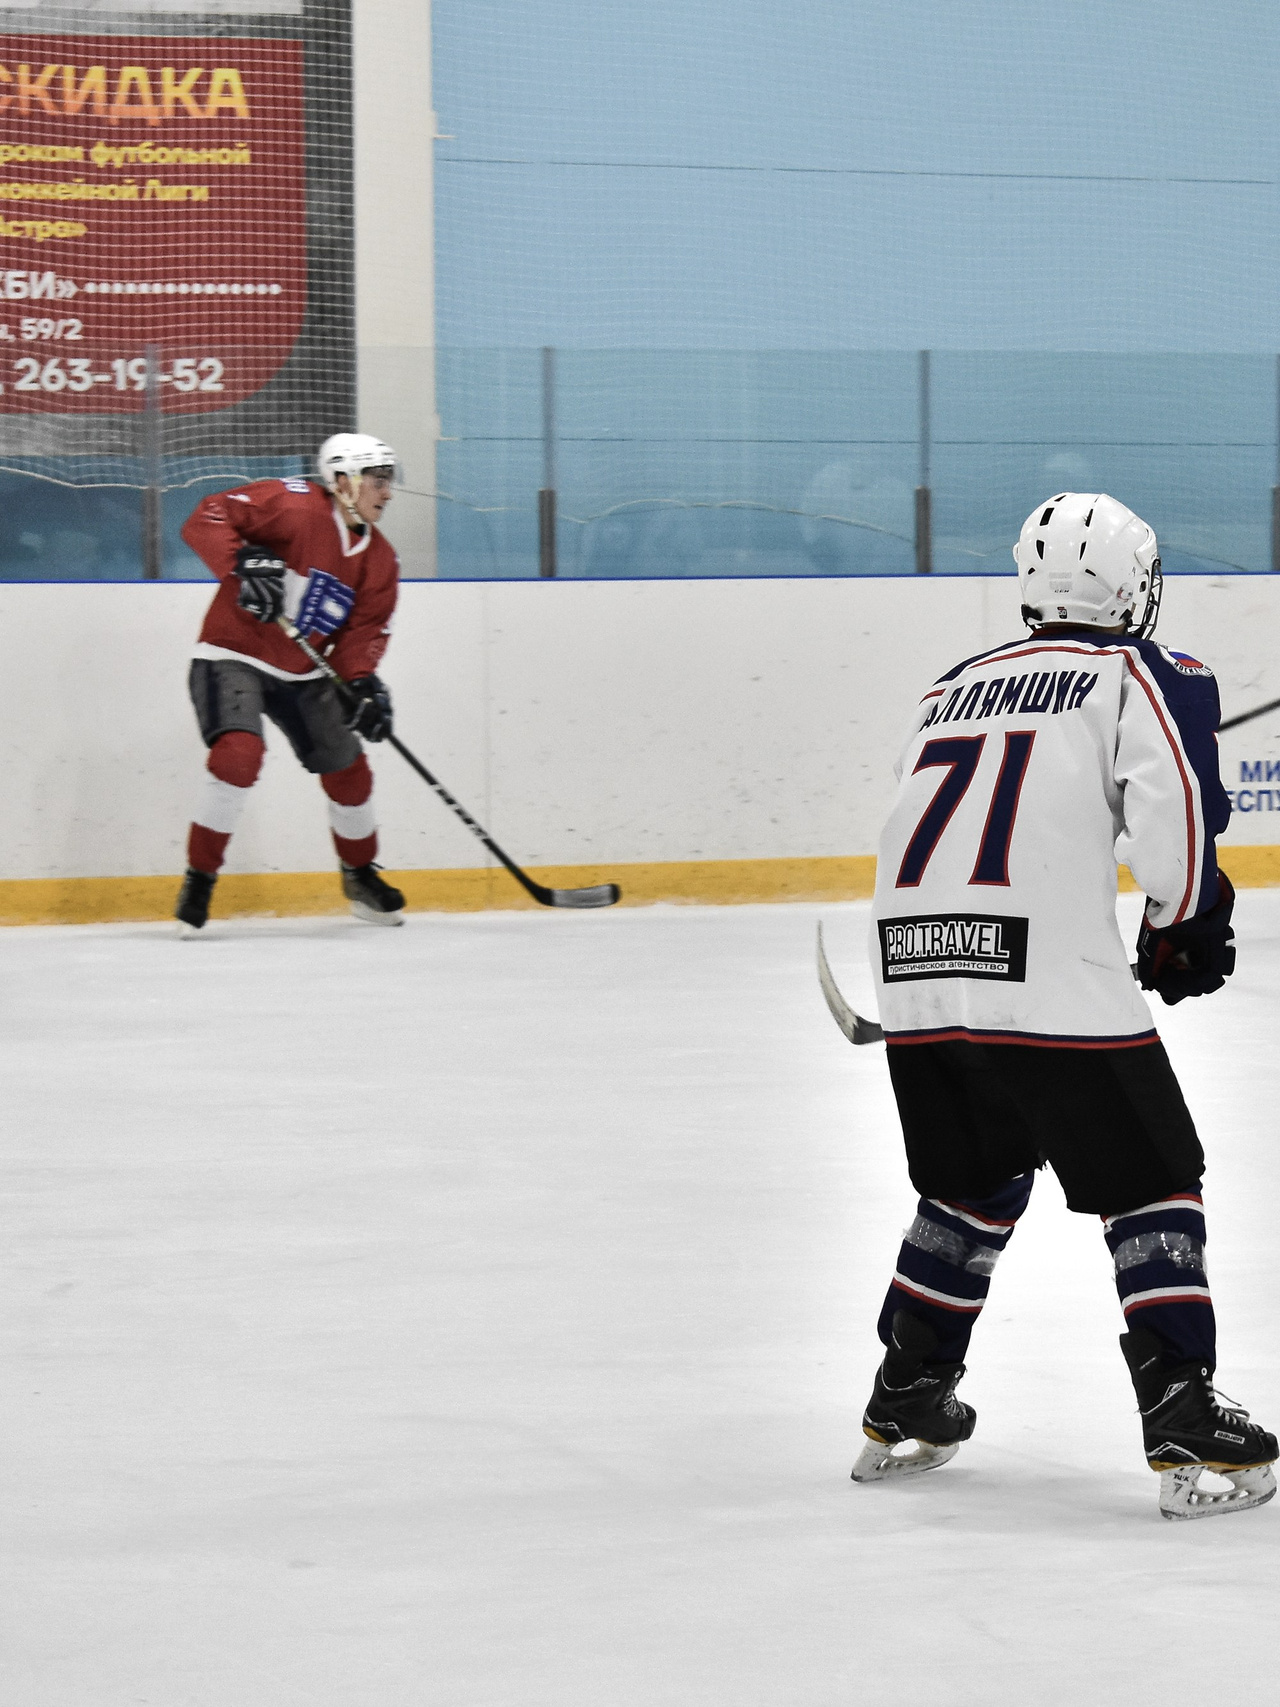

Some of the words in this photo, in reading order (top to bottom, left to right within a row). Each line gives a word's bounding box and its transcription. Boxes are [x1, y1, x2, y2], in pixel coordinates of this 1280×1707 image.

[20, 318, 83, 340] 59/2
[14, 357, 224, 391] 263-19-52
[895, 729, 1037, 888] 71
[885, 921, 1010, 961] PRO.TRAVEL
[948, 961, 1005, 971] агентство
